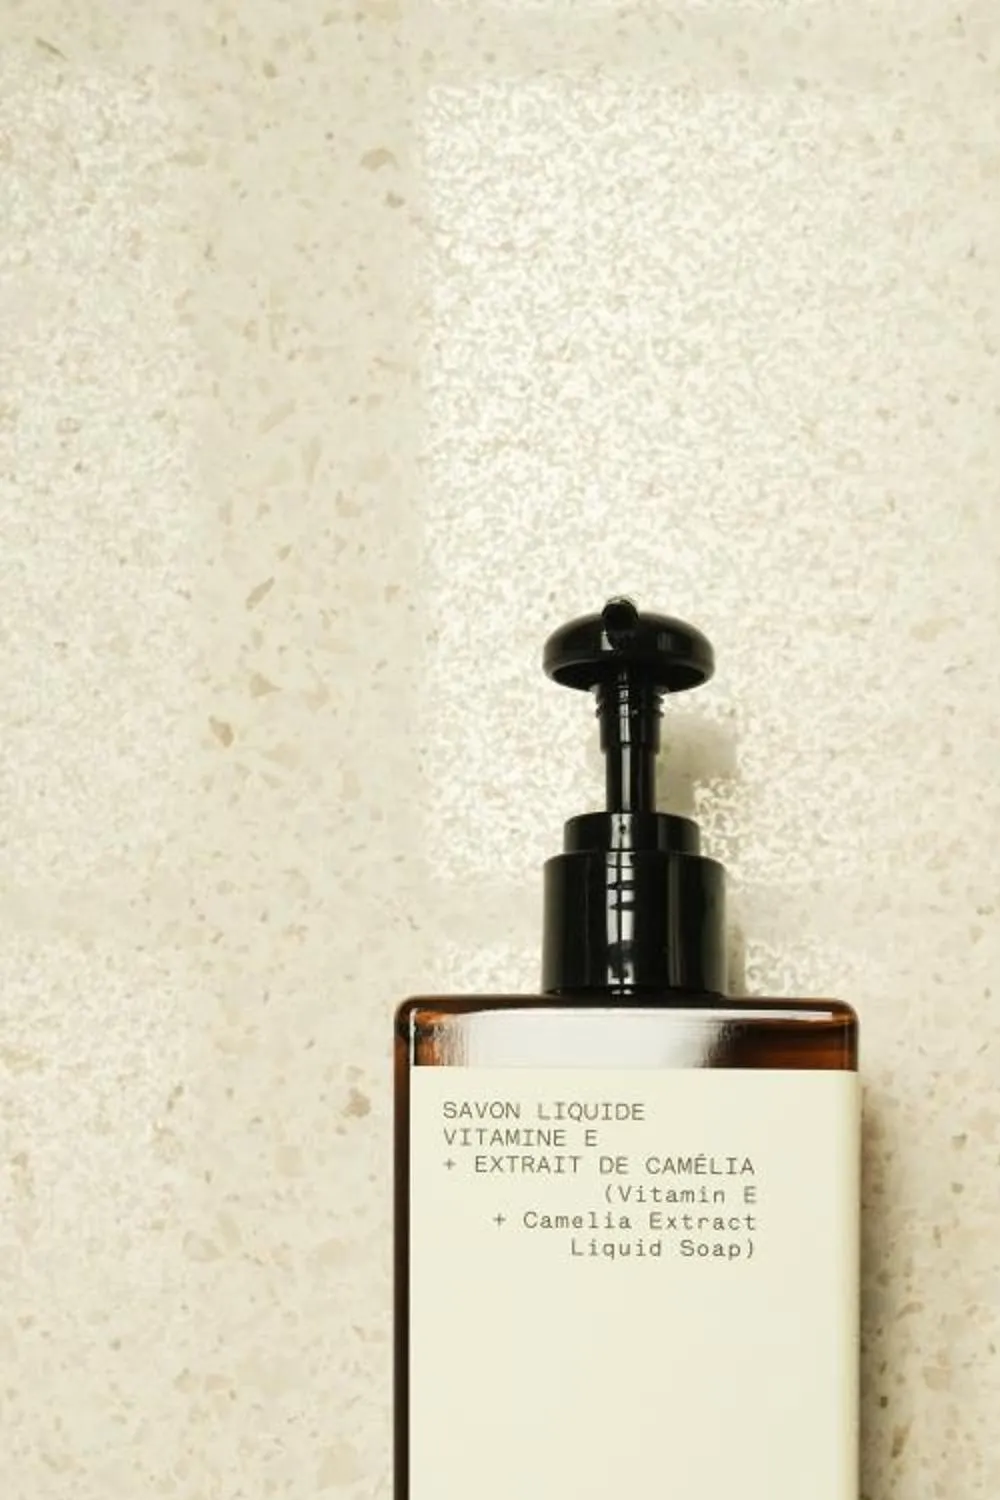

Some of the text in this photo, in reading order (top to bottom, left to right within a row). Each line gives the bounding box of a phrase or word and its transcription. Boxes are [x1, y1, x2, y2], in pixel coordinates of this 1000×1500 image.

[443, 1101, 646, 1122] SAVON LIQUIDE
[443, 1128, 598, 1147] VITAMINE E
[443, 1153, 755, 1175] + EXTRAIT DE CAMÉLIA
[604, 1184, 756, 1204] (Vitamin E
[493, 1211, 756, 1231] + Camelia Extract
[571, 1239, 755, 1259] Liquid Soap)
